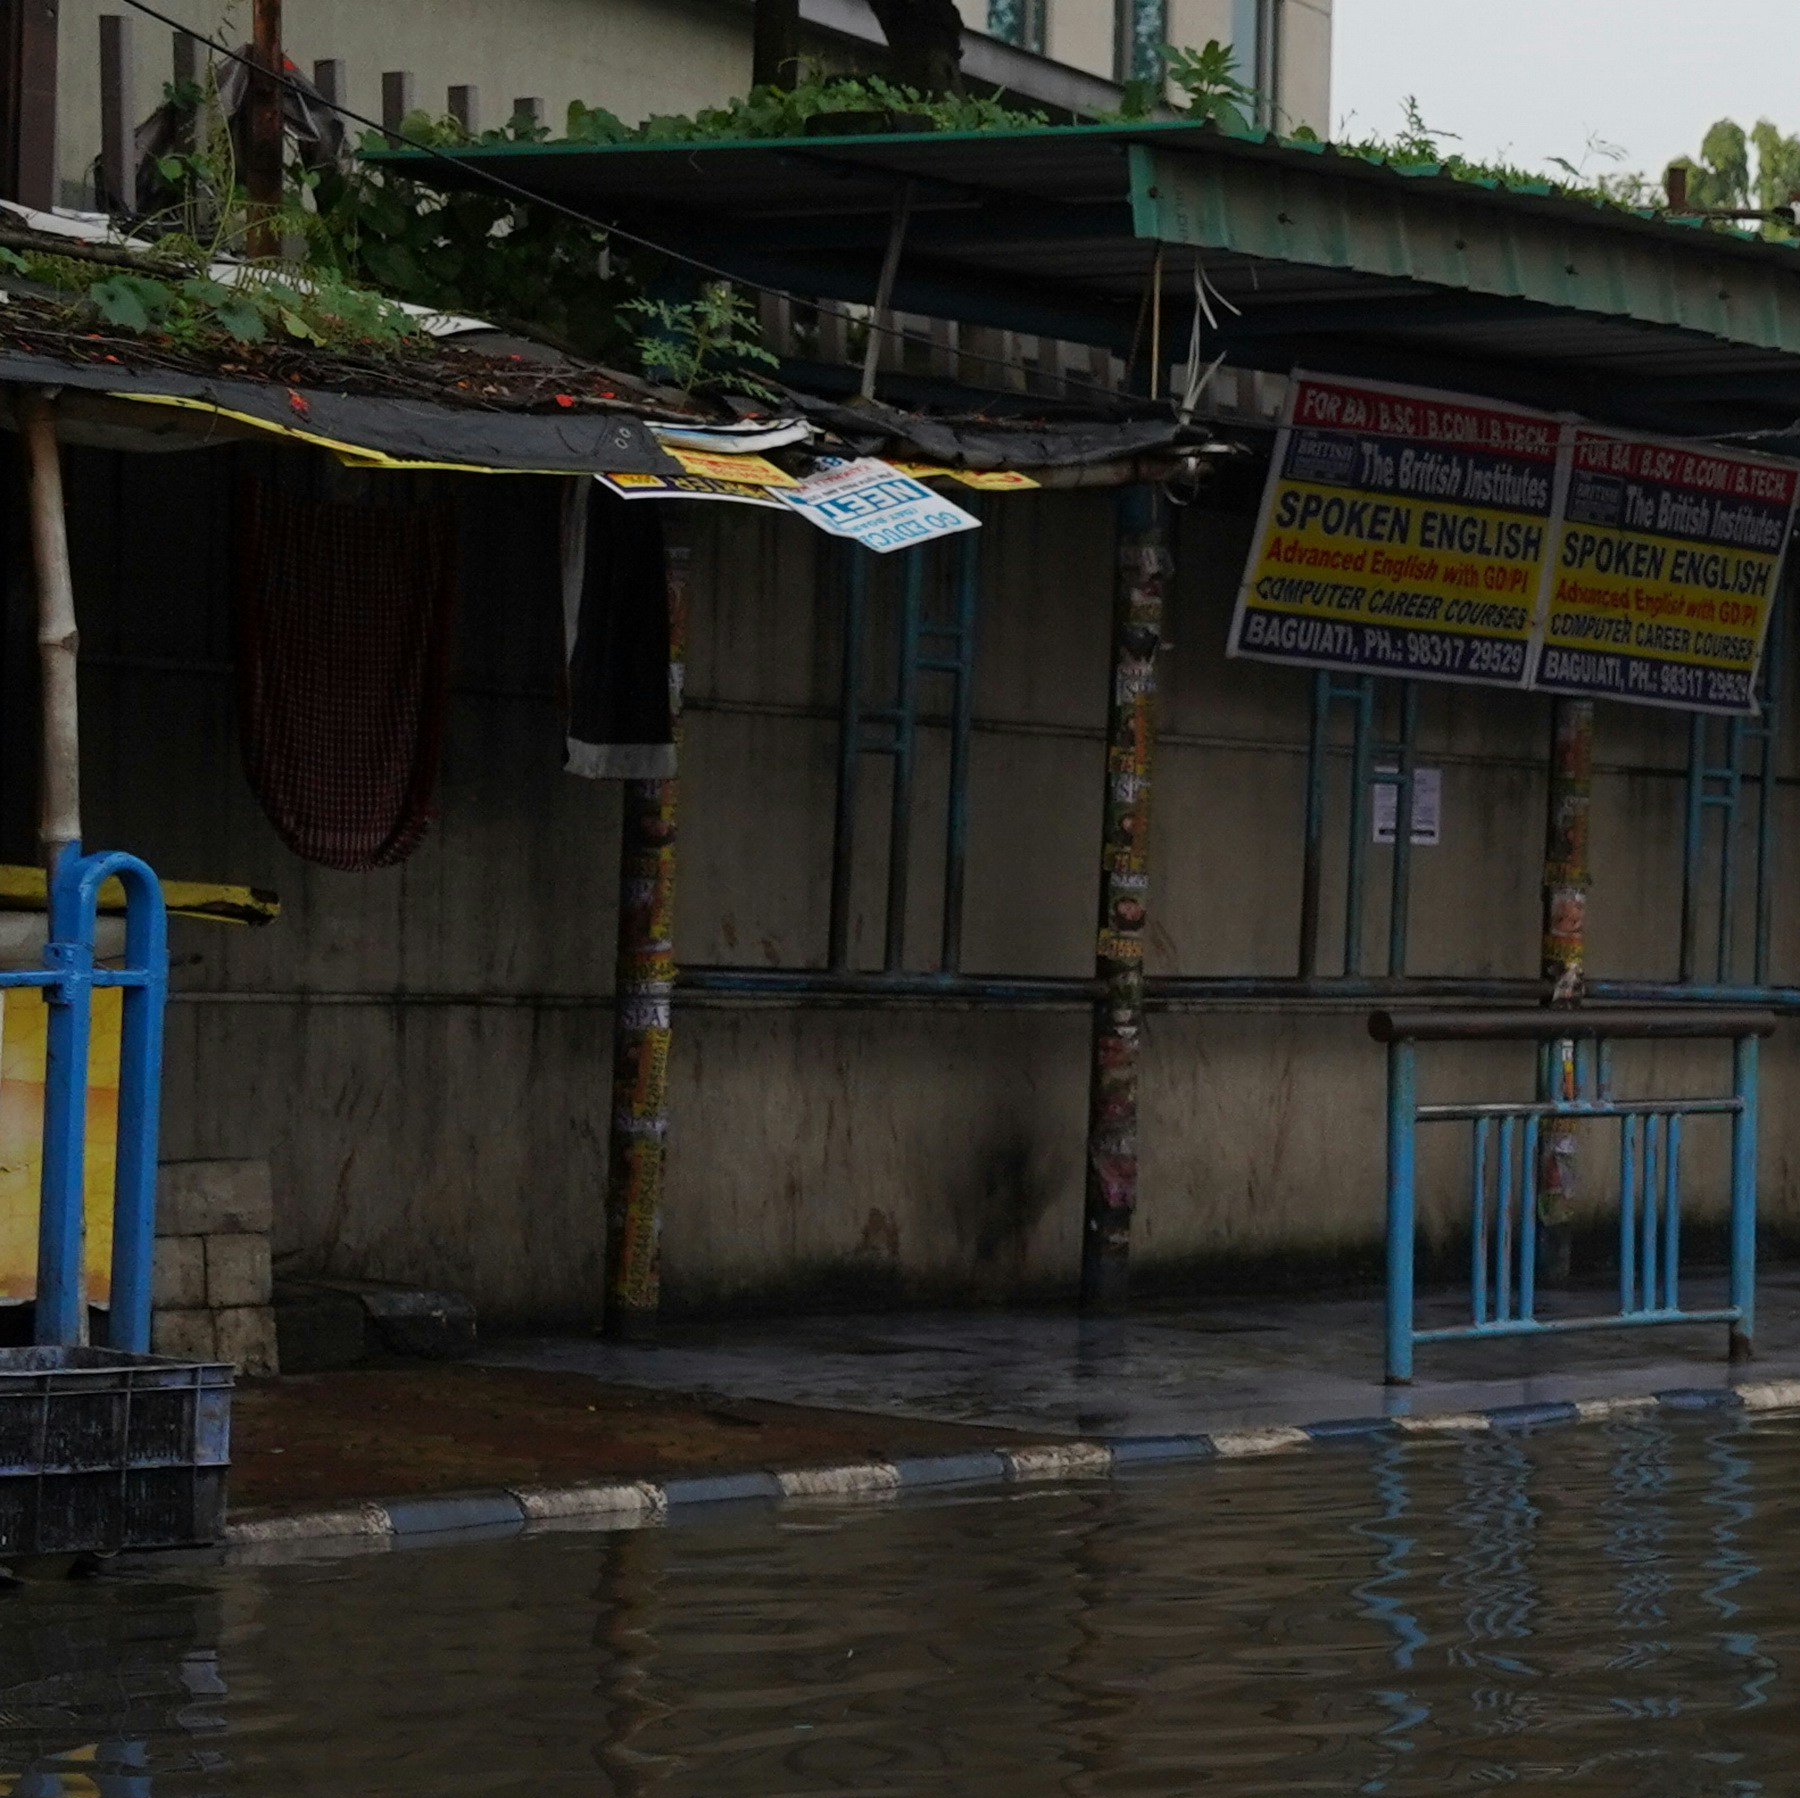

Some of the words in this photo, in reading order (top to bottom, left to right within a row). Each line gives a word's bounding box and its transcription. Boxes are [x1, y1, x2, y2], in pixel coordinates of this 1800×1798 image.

[1303, 389, 1340, 421] FOR
[1343, 398, 1368, 427] BA
[1380, 403, 1416, 435] B.SC
[1426, 412, 1476, 447] B.COM
[1361, 442, 1394, 487] The
[1399, 449, 1461, 497] British
[1463, 458, 1547, 508] Institutes
[1579, 438, 1607, 468] FOR
[1610, 443, 1631, 472] BA
[1641, 449, 1674, 480] B.SC
[1683, 456, 1728, 489] B.COM
[816, 480, 932, 523] NEET
[923, 511, 961, 529] GO
[1276, 490, 1410, 543] SPOKEN
[1420, 510, 1542, 561] ENGLISH
[1625, 484, 1655, 528] The
[1657, 490, 1710, 536] British
[1711, 498, 1781, 549] Institutes
[1266, 536, 1367, 572] Advanced
[1370, 551, 1438, 582] English
[1443, 564, 1479, 588] with
[1562, 531, 1666, 580] SPOKEN
[1669, 550, 1773, 597] ENGLISH
[1256, 576, 1365, 610] COMPUTER
[1369, 590, 1441, 620] CAREER
[1444, 601, 1527, 630] COURSES
[1556, 579, 1630, 610] Advanced
[1635, 589, 1685, 618] English
[1686, 598, 1714, 621] with
[1246, 613, 1358, 661] BAGUIATI,
[1407, 634, 1463, 667] 98317
[1469, 641, 1522, 674] 29529
[1551, 612, 1631, 644] COMPUTER
[1636, 622, 1690, 653] CAREER
[1694, 631, 1755, 662] COURSES
